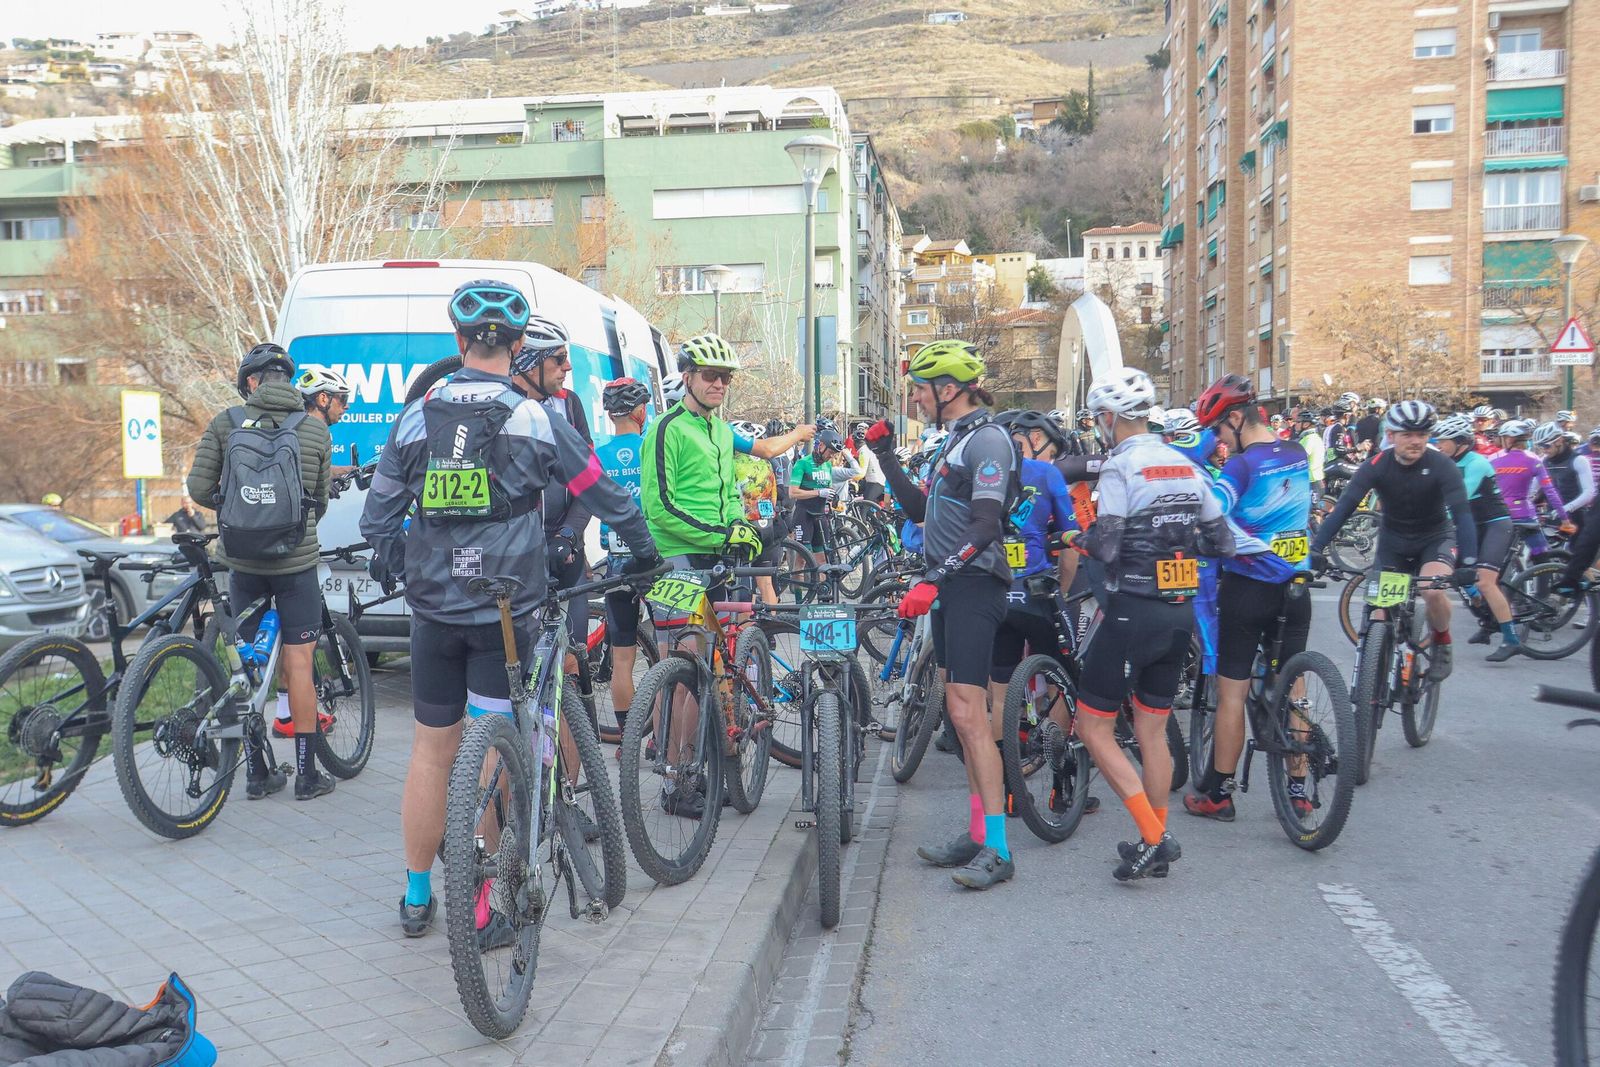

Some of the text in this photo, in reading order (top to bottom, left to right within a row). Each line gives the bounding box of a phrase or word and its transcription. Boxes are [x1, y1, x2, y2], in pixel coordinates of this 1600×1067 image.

[338, 413, 383, 423] QUILER
[428, 472, 484, 500] 312-2
[1163, 561, 1194, 582] 511-1
[652, 580, 700, 607] 312-1
[1381, 584, 1406, 598] 644
